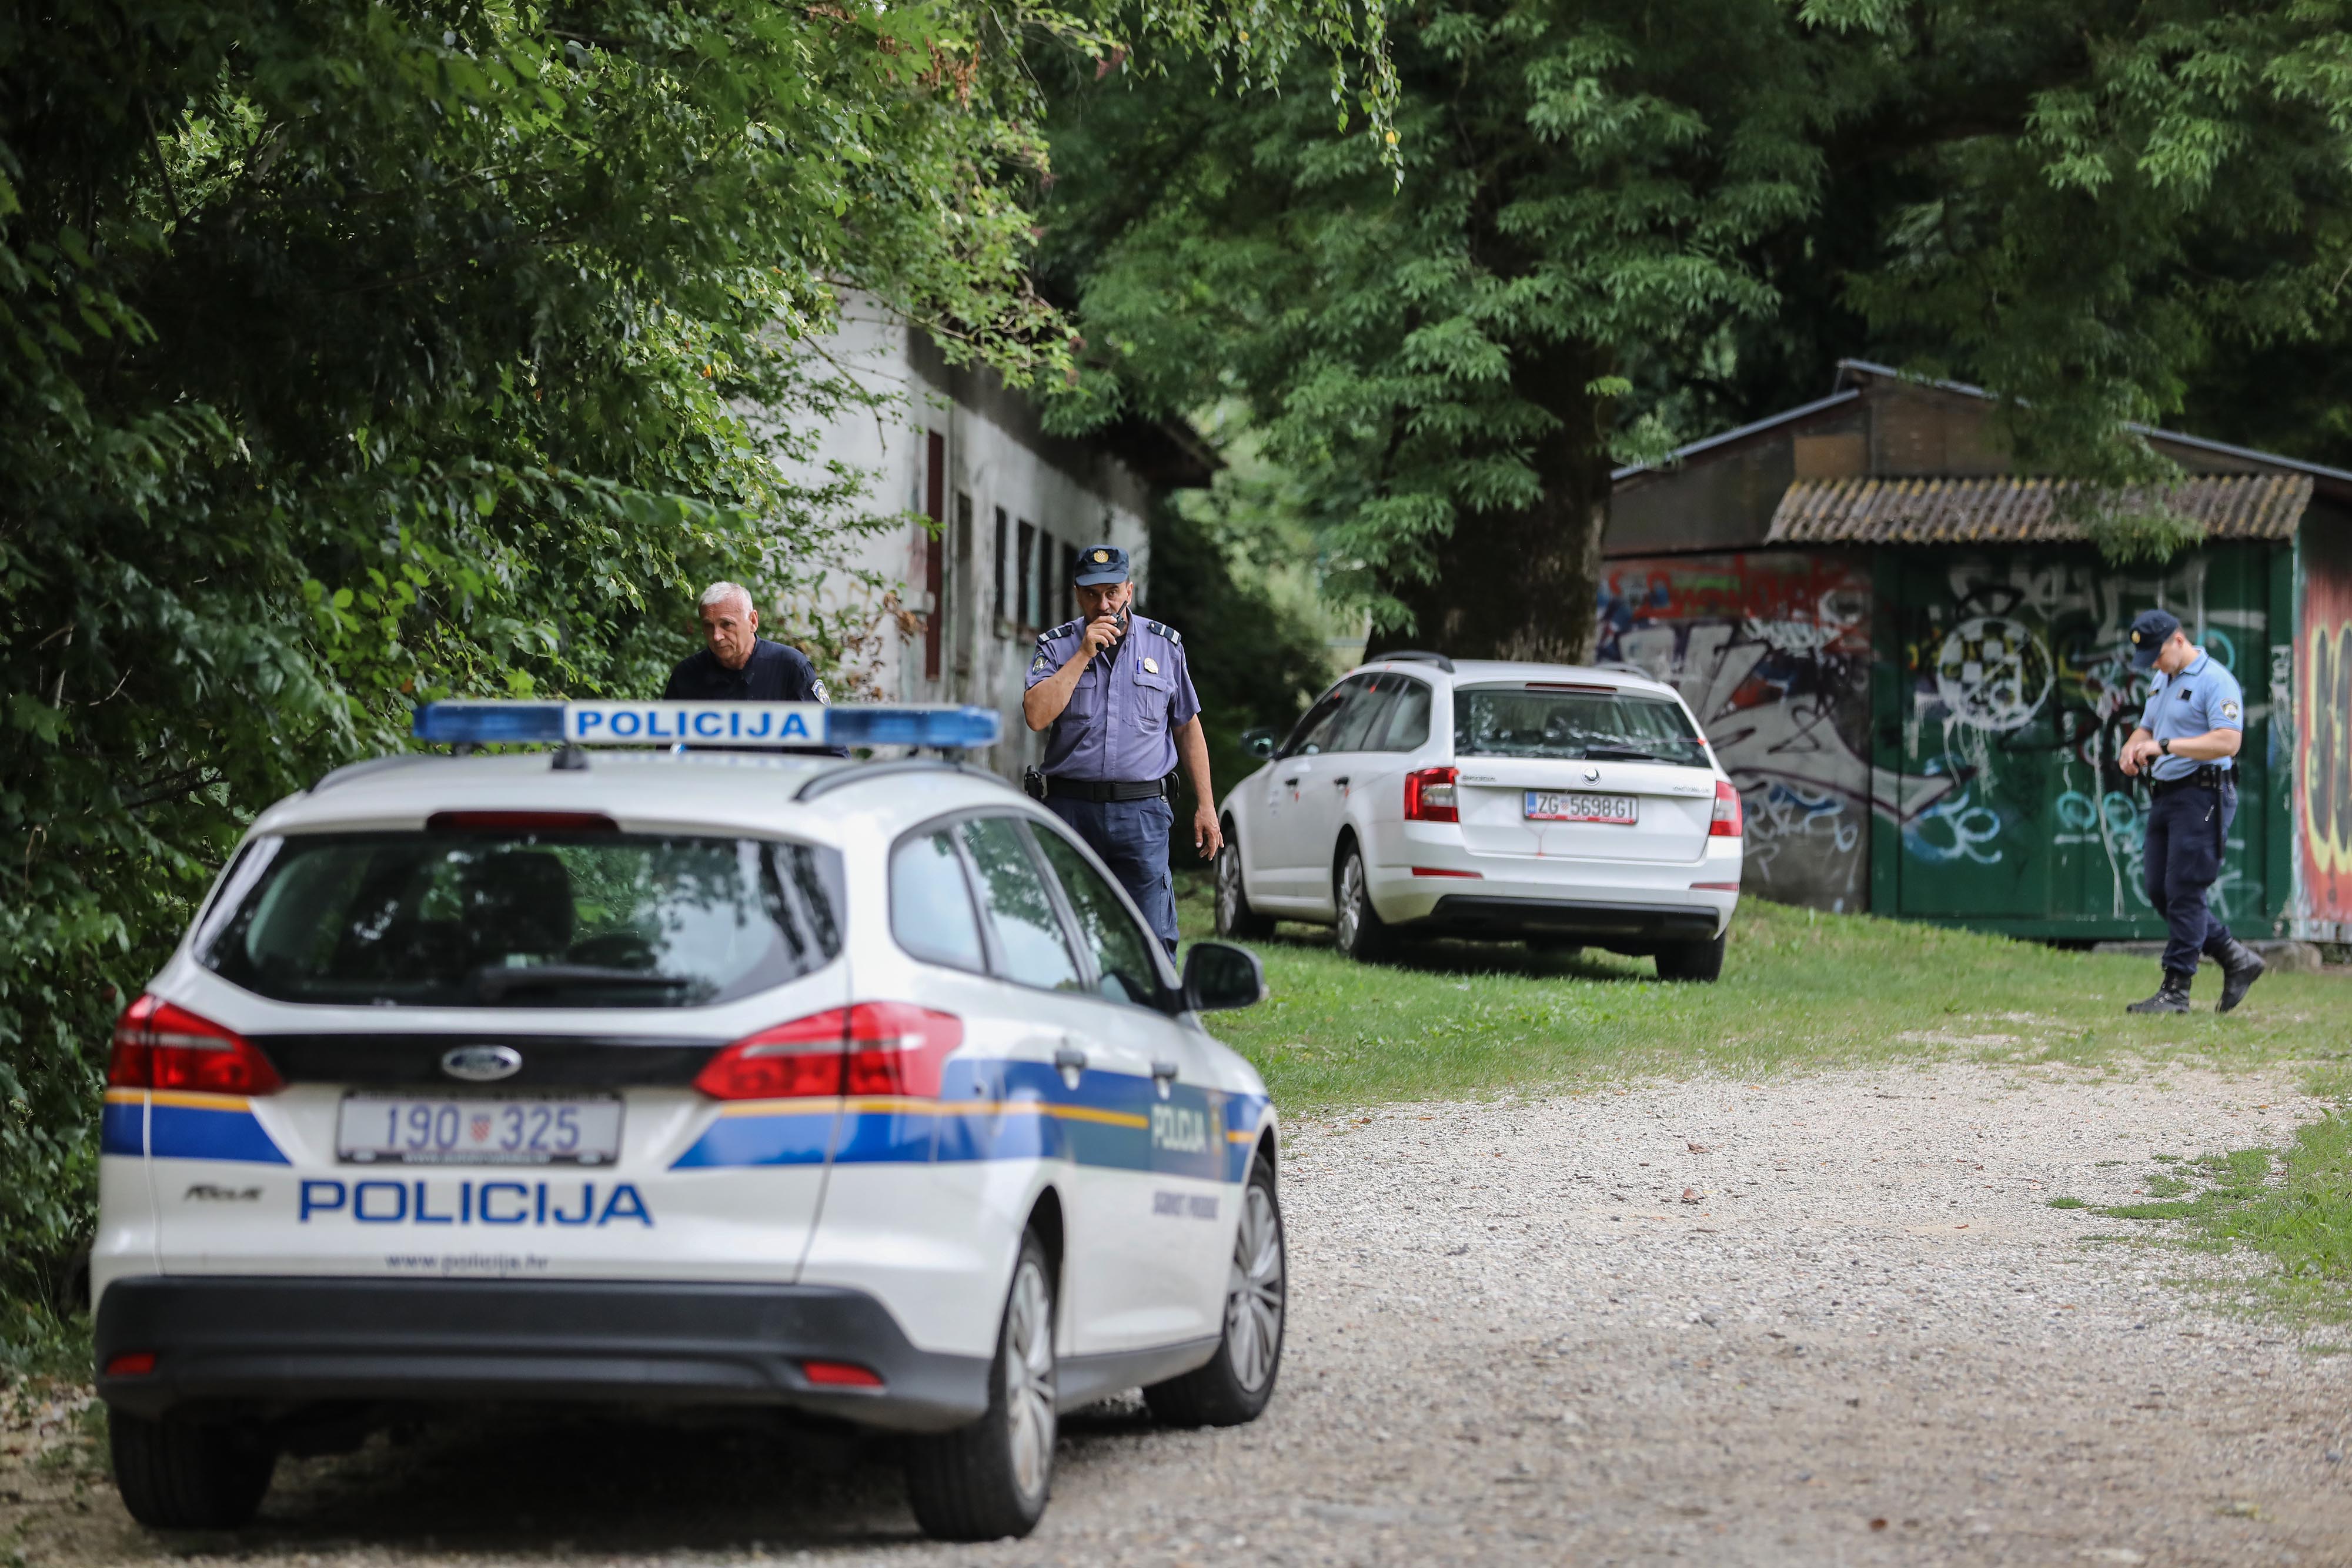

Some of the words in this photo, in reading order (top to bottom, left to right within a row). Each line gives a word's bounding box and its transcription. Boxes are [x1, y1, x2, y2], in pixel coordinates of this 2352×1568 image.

[577, 710, 811, 740] POLICIJA
[1538, 795, 1559, 814] ZG
[387, 1104, 460, 1151] 190
[500, 1104, 581, 1151] 325
[298, 1180, 655, 1228] POLICIJA
